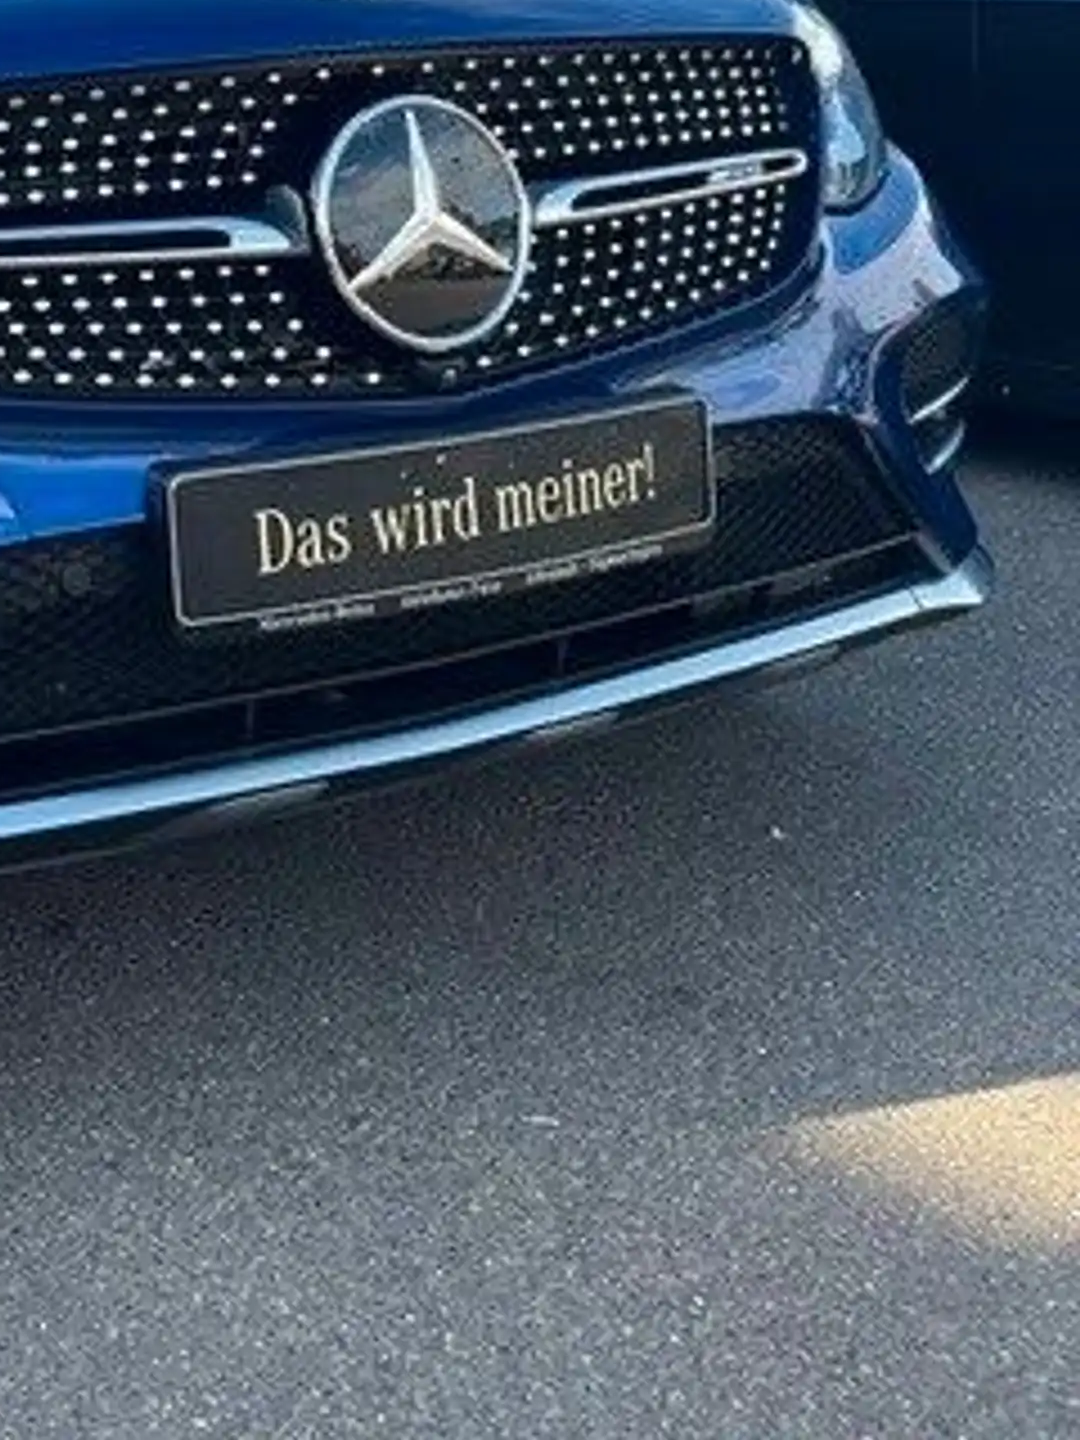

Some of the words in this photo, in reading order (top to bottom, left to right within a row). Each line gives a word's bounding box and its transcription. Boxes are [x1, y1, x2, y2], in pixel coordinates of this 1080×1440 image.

[255, 507, 351, 575] Das
[370, 475, 481, 555] wird
[495, 442, 657, 534] meiner!
